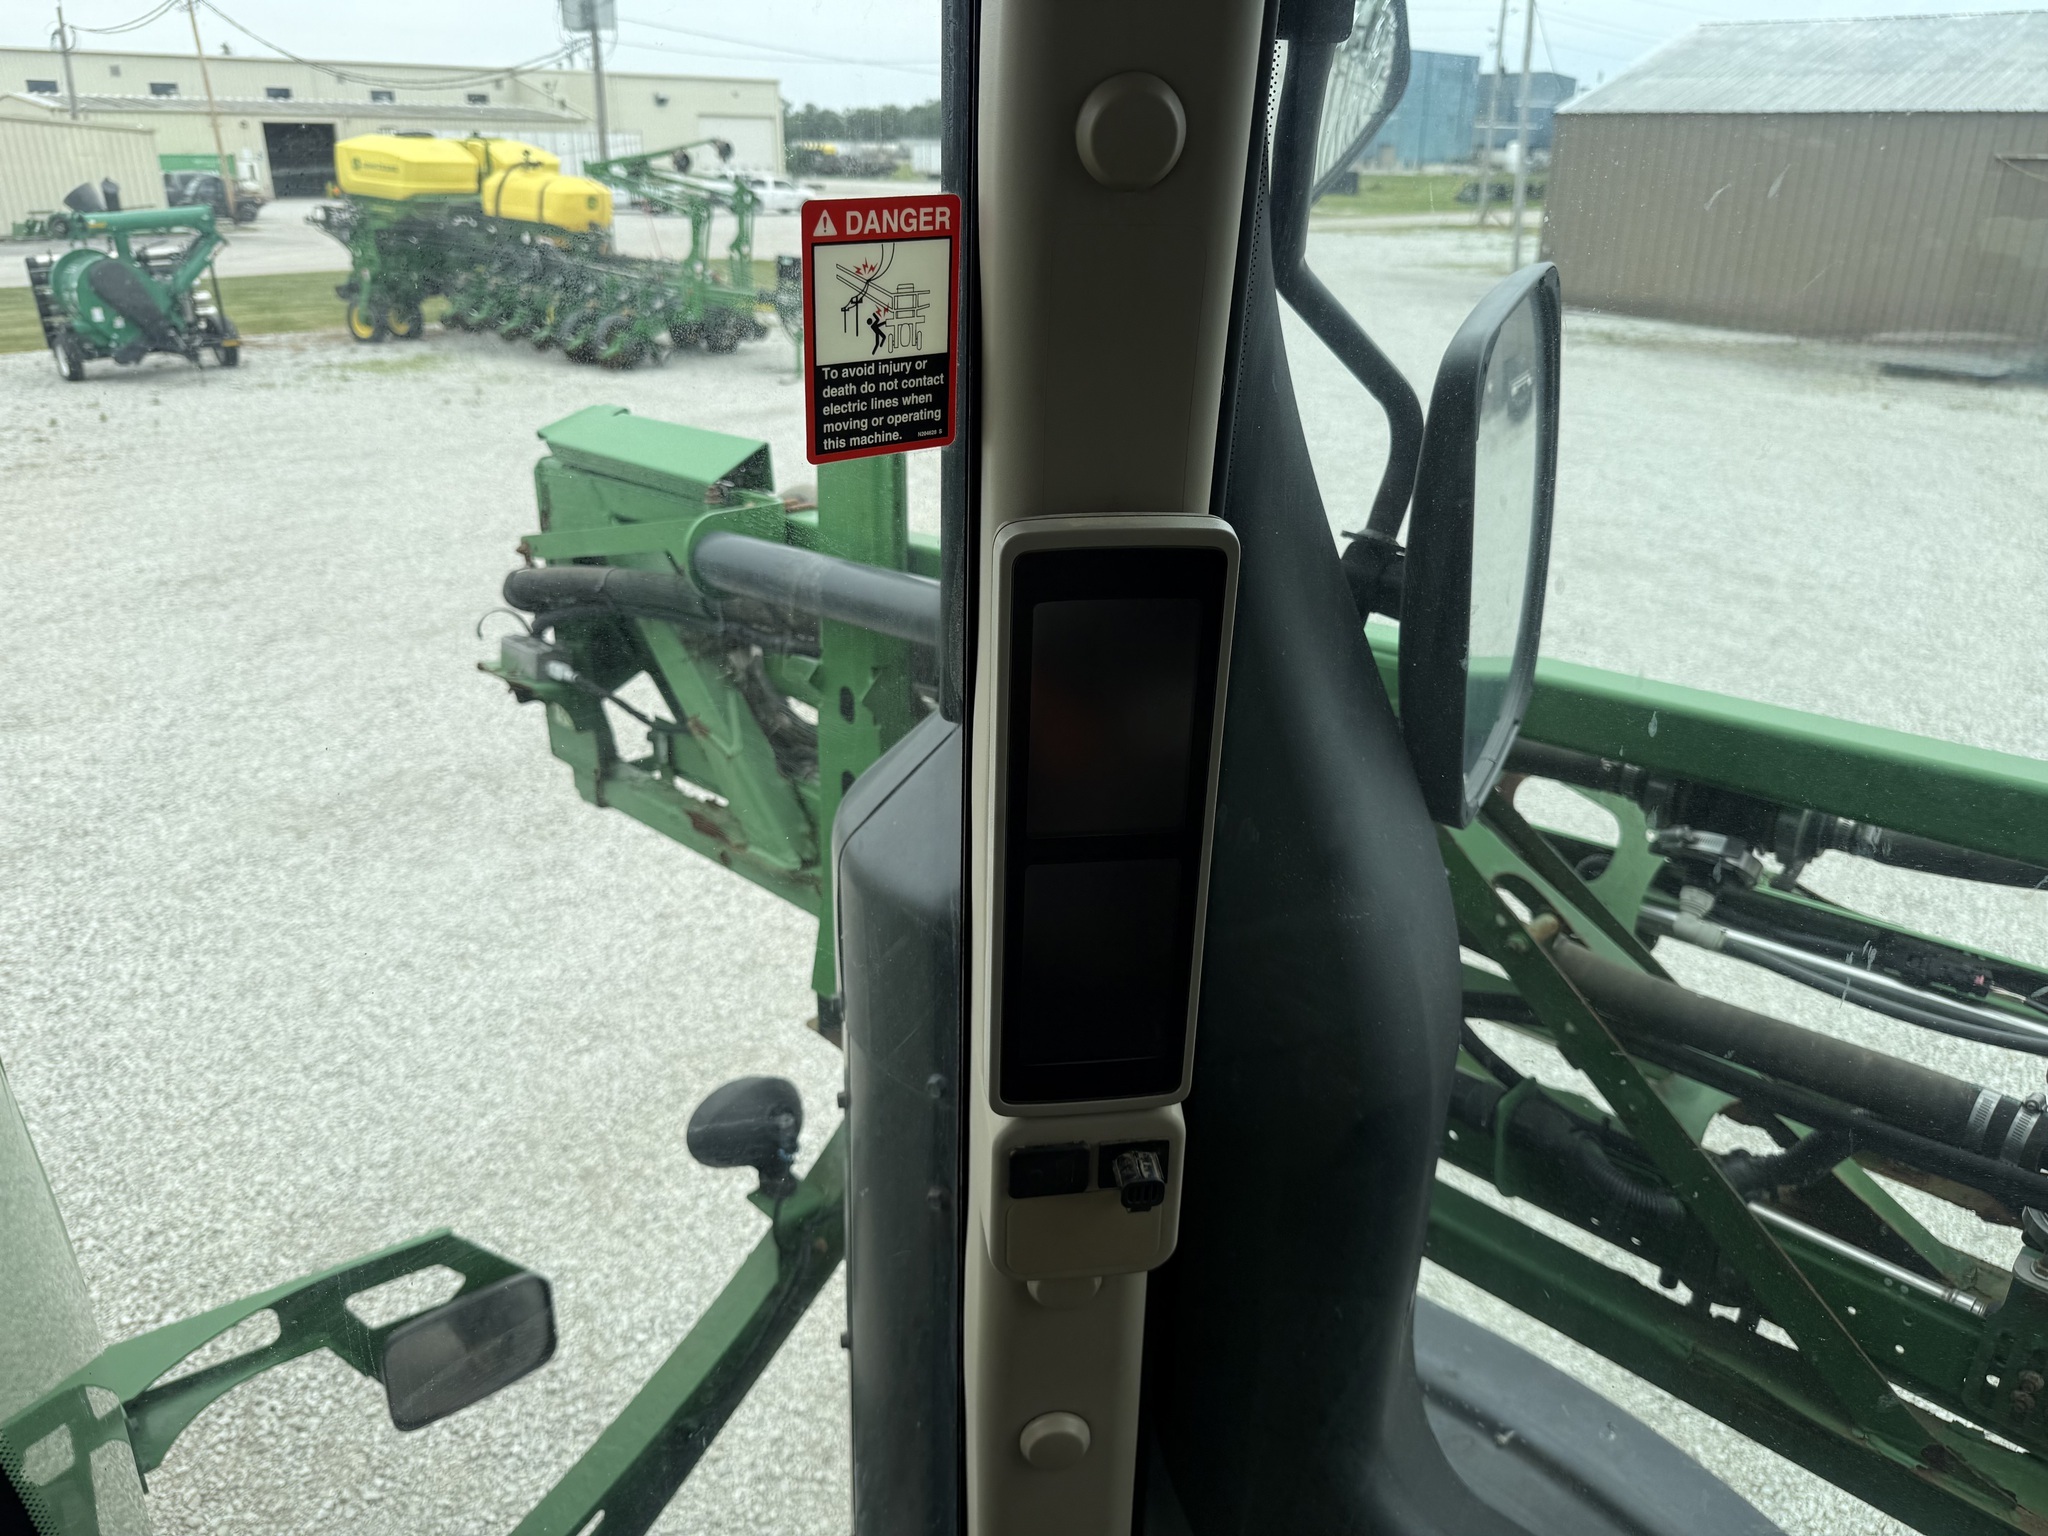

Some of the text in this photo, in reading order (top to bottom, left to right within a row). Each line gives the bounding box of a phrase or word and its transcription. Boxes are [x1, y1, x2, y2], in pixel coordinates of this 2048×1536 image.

[846, 206, 951, 235] DANGER
[822, 359, 928, 380] To avoid injury or
[822, 373, 944, 398] death do not contact
[822, 392, 933, 416] electric lines when
[823, 408, 942, 433] moving or operating
[822, 430, 903, 450] this machine.
